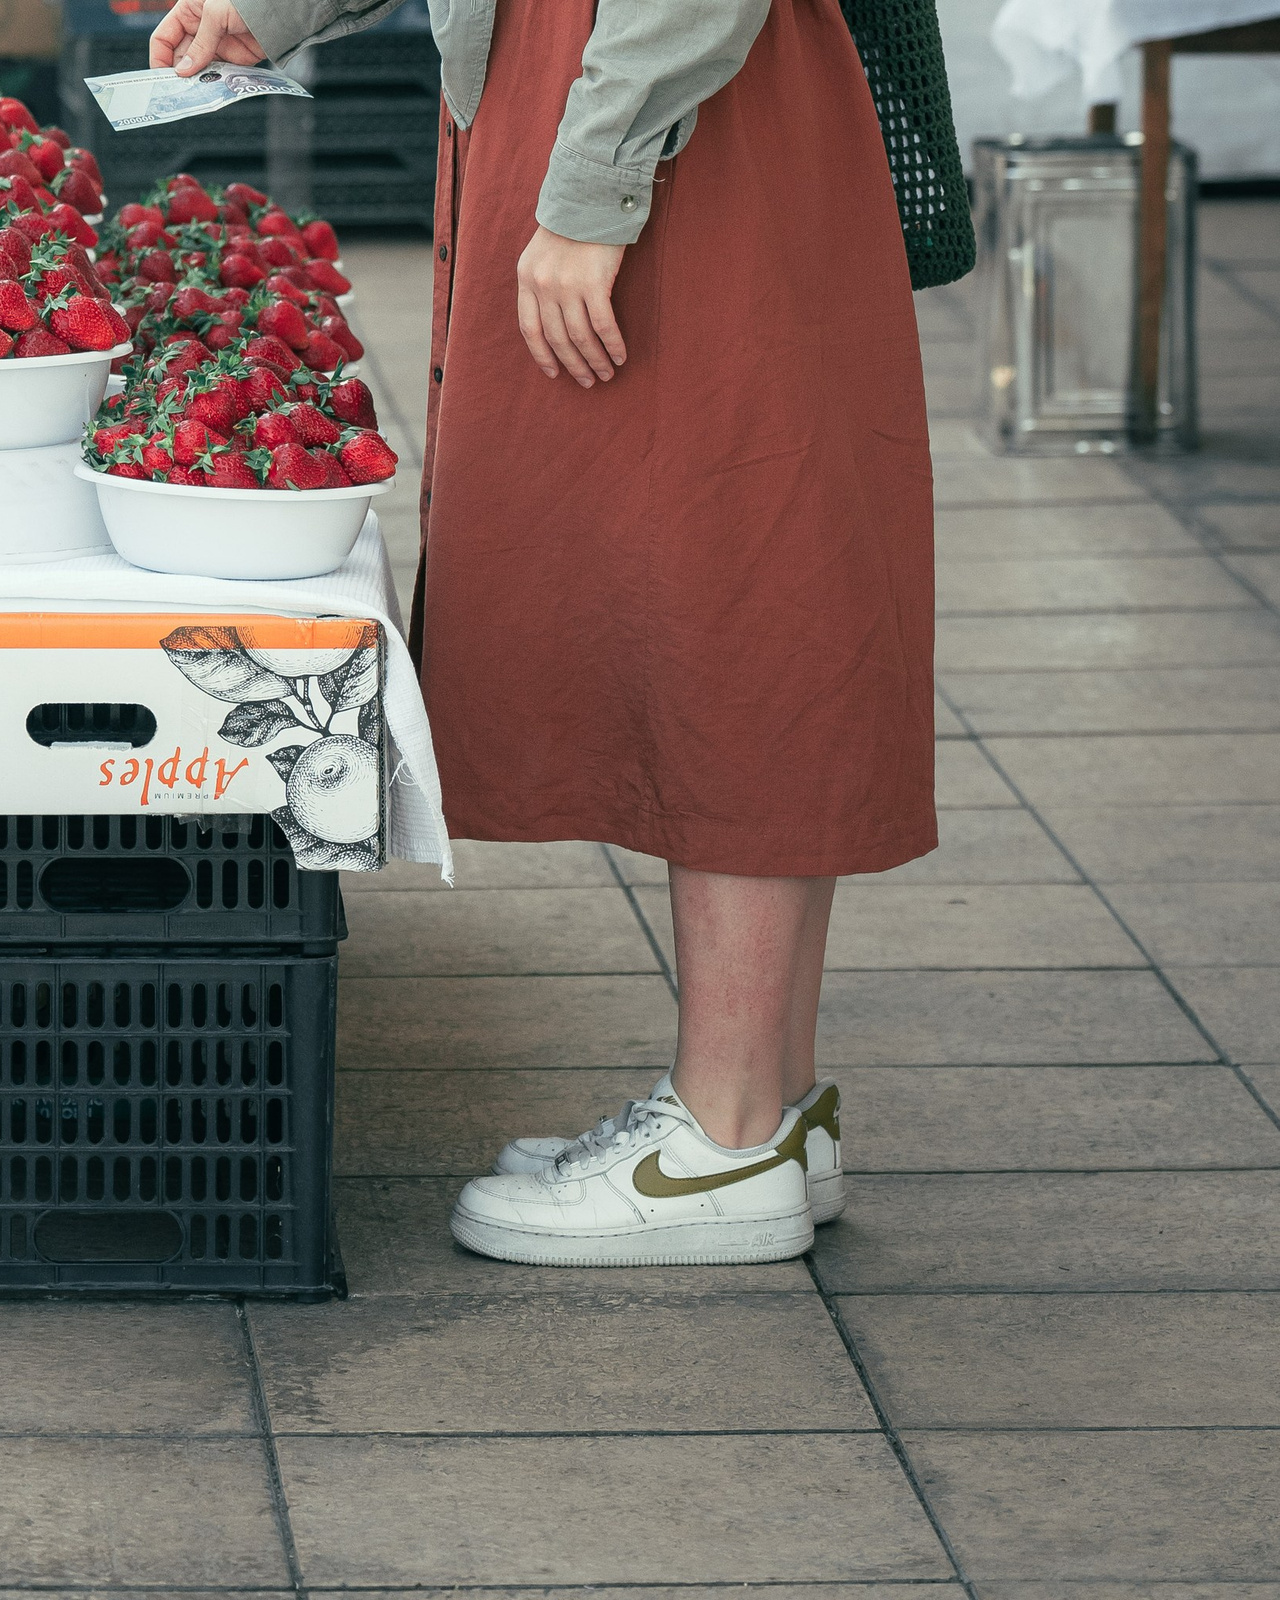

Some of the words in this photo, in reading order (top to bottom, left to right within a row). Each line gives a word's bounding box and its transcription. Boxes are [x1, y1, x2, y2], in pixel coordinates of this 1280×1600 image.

[233, 85, 303, 96] 200000
[117, 114, 155, 127] 200000
[98, 746, 250, 806] Apples
[749, 1232, 775, 1247] AIR
